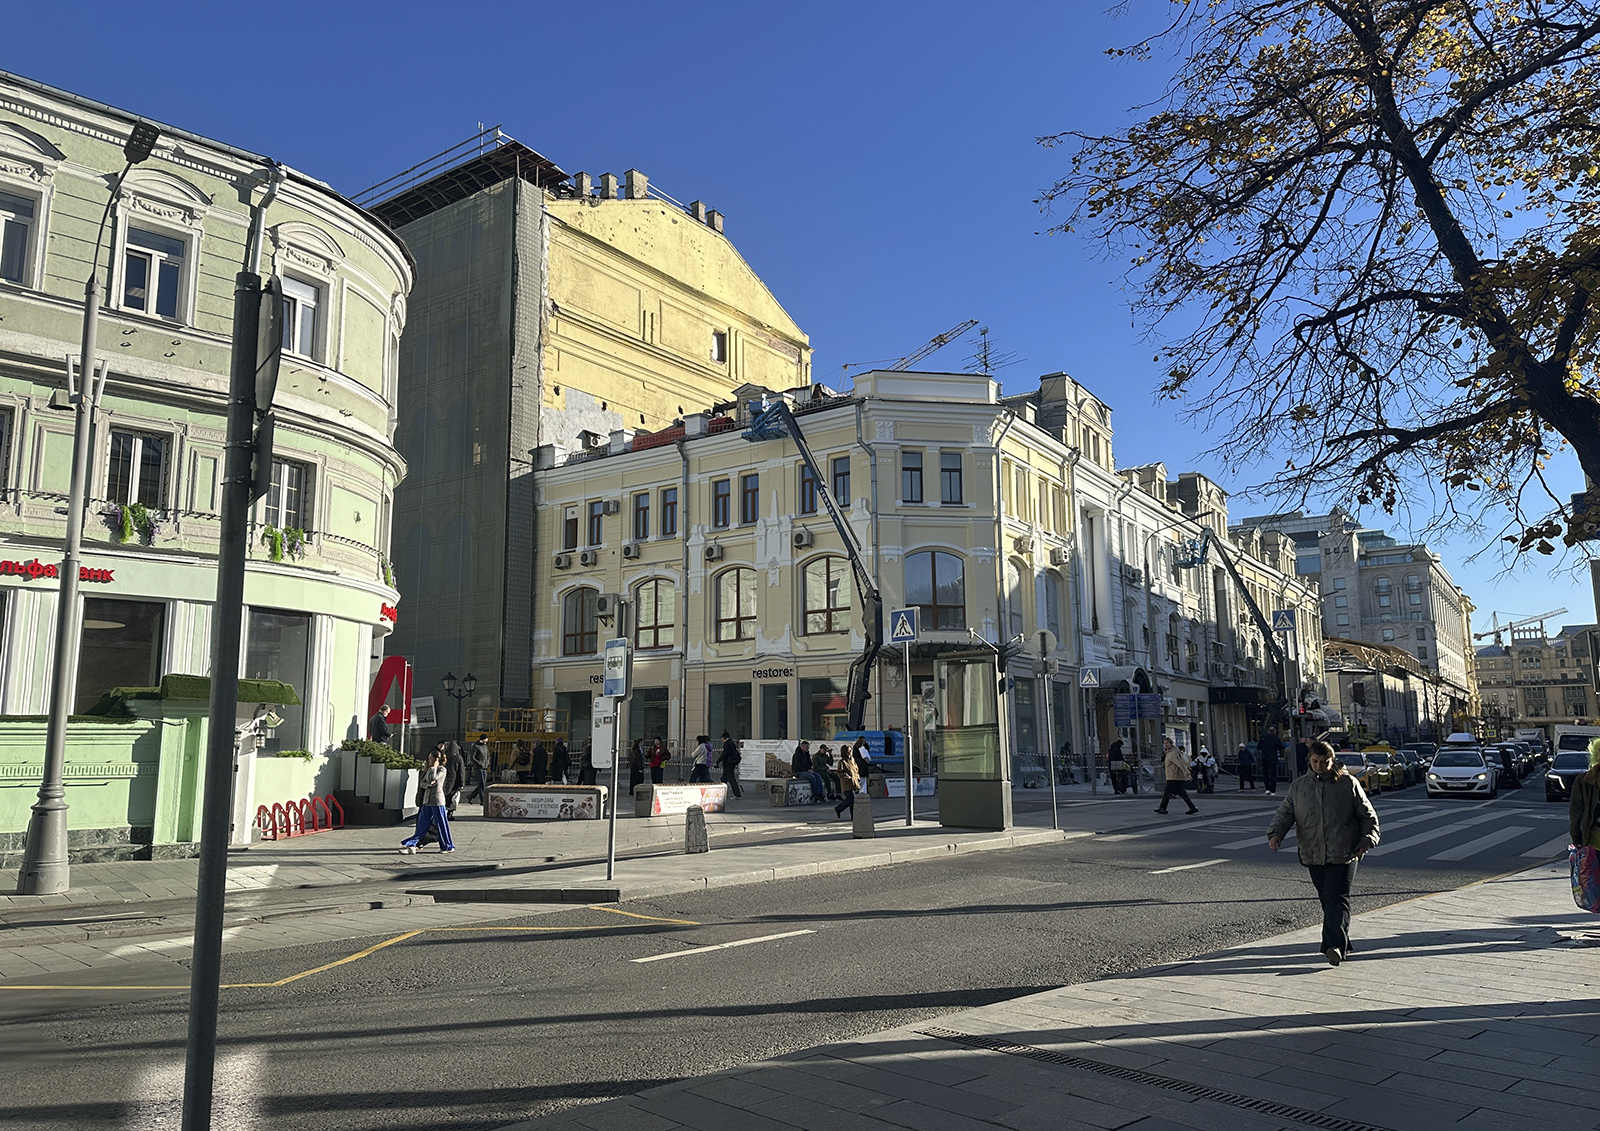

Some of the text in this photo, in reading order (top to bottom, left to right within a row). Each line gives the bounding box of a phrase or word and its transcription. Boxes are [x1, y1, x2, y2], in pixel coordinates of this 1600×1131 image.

[0, 558, 115, 581] льфа анк
[589, 674, 604, 684] res
